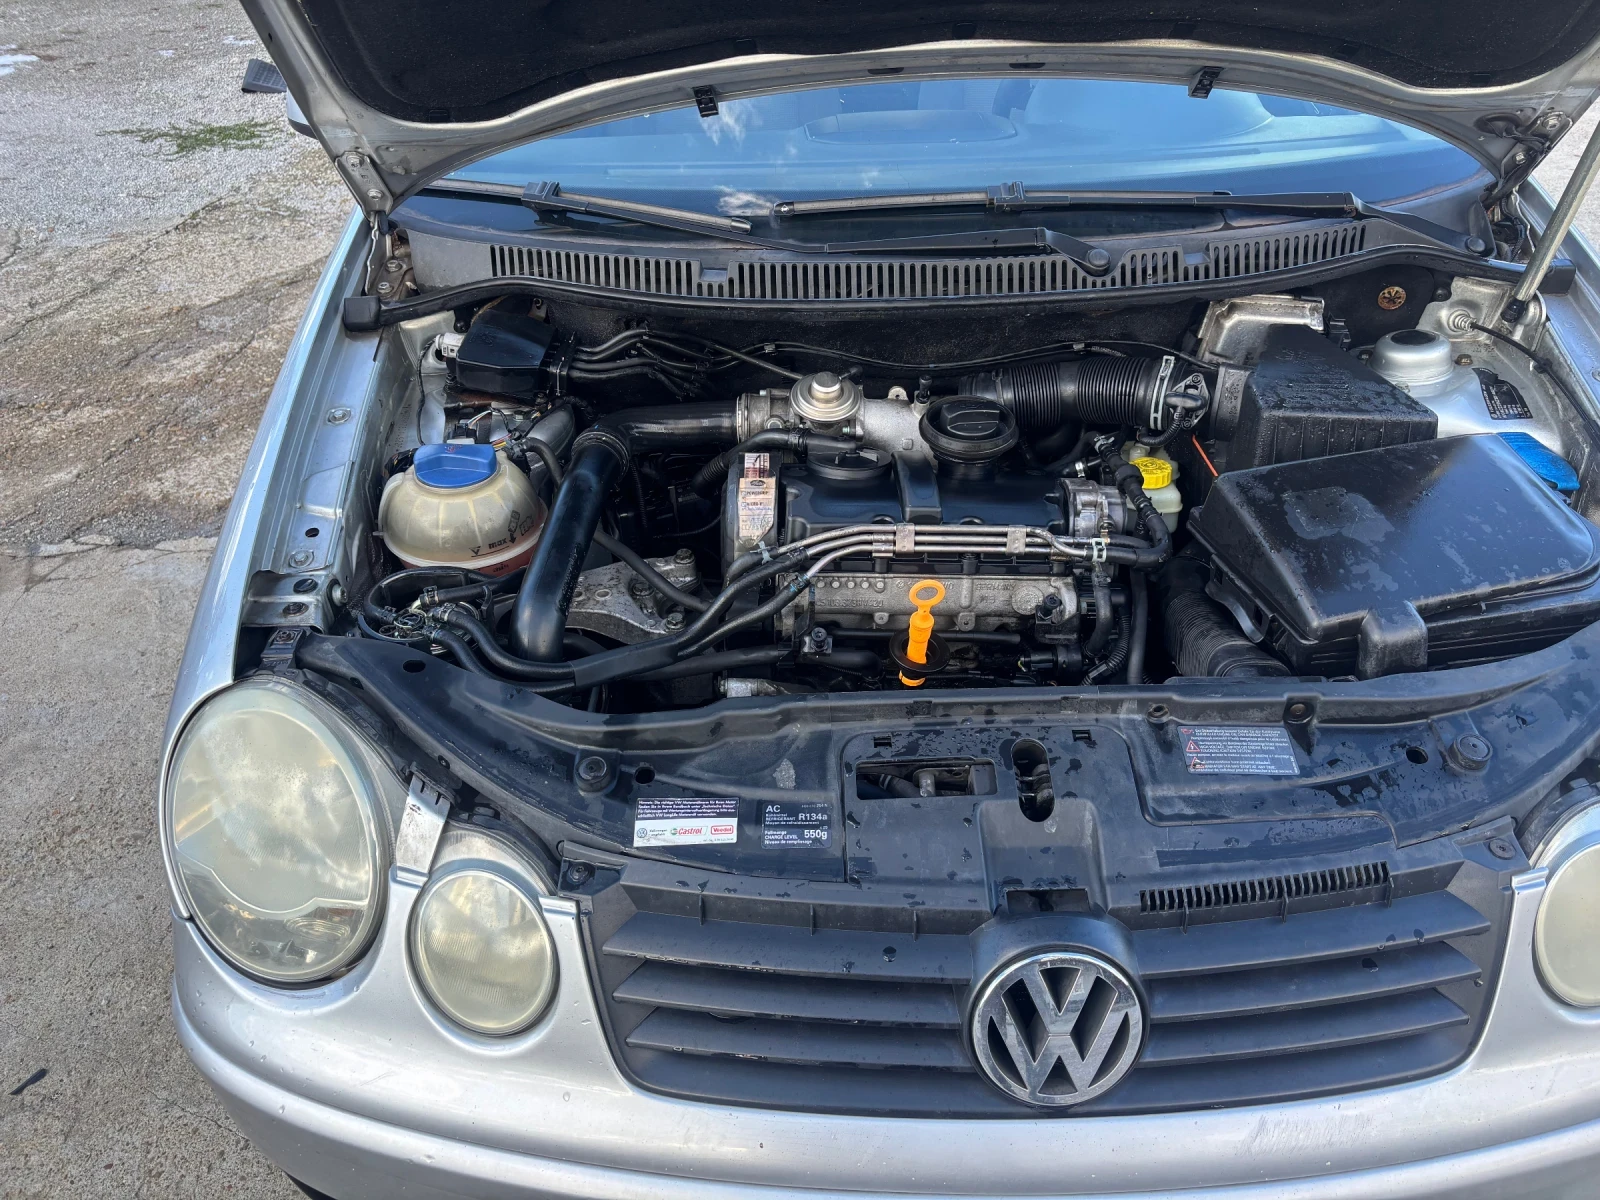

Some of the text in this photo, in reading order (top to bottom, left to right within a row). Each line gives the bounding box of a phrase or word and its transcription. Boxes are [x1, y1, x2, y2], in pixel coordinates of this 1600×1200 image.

[488, 538, 508, 549] max
[798, 813, 828, 821] R134a
[678, 827, 703, 836] Castrol
[804, 830, 828, 840] 550g
